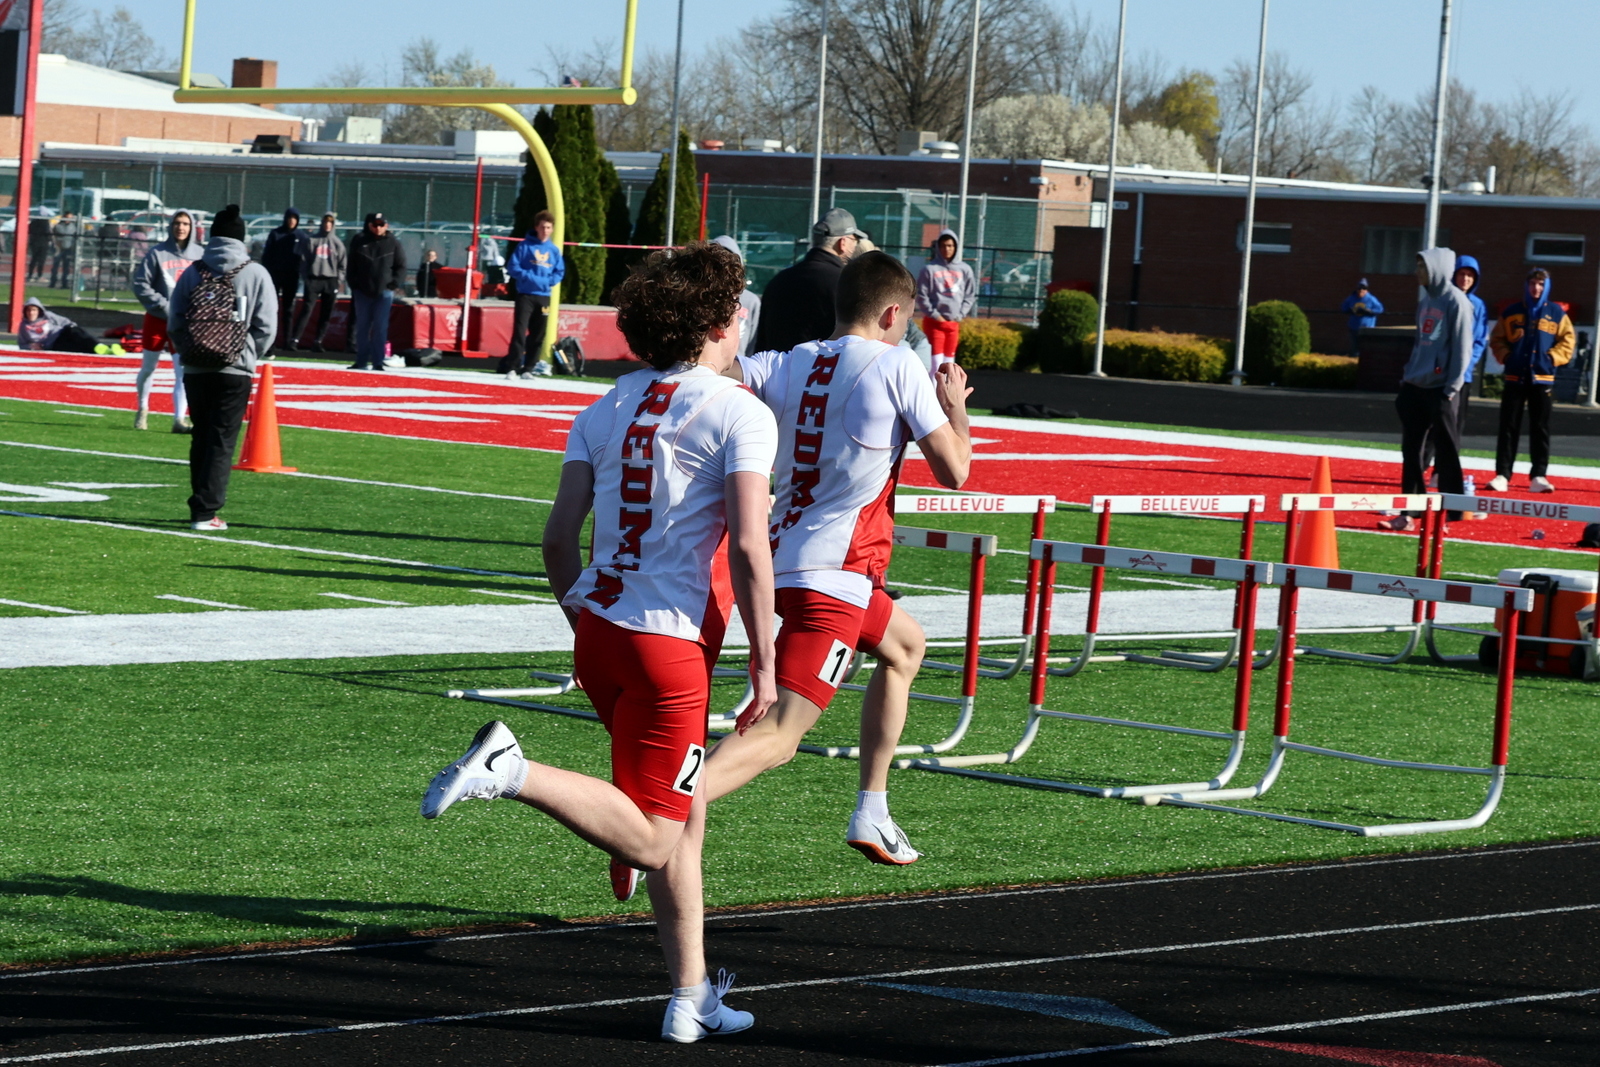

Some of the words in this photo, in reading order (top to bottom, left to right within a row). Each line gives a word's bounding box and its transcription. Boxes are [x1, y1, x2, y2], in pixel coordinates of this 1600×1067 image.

[917, 497, 1005, 511] BELLEVUE
[1141, 498, 1220, 511] BELLEVUE
[1477, 498, 1569, 519] BELLEVUE
[829, 647, 847, 683] 1
[679, 748, 702, 793] 2
